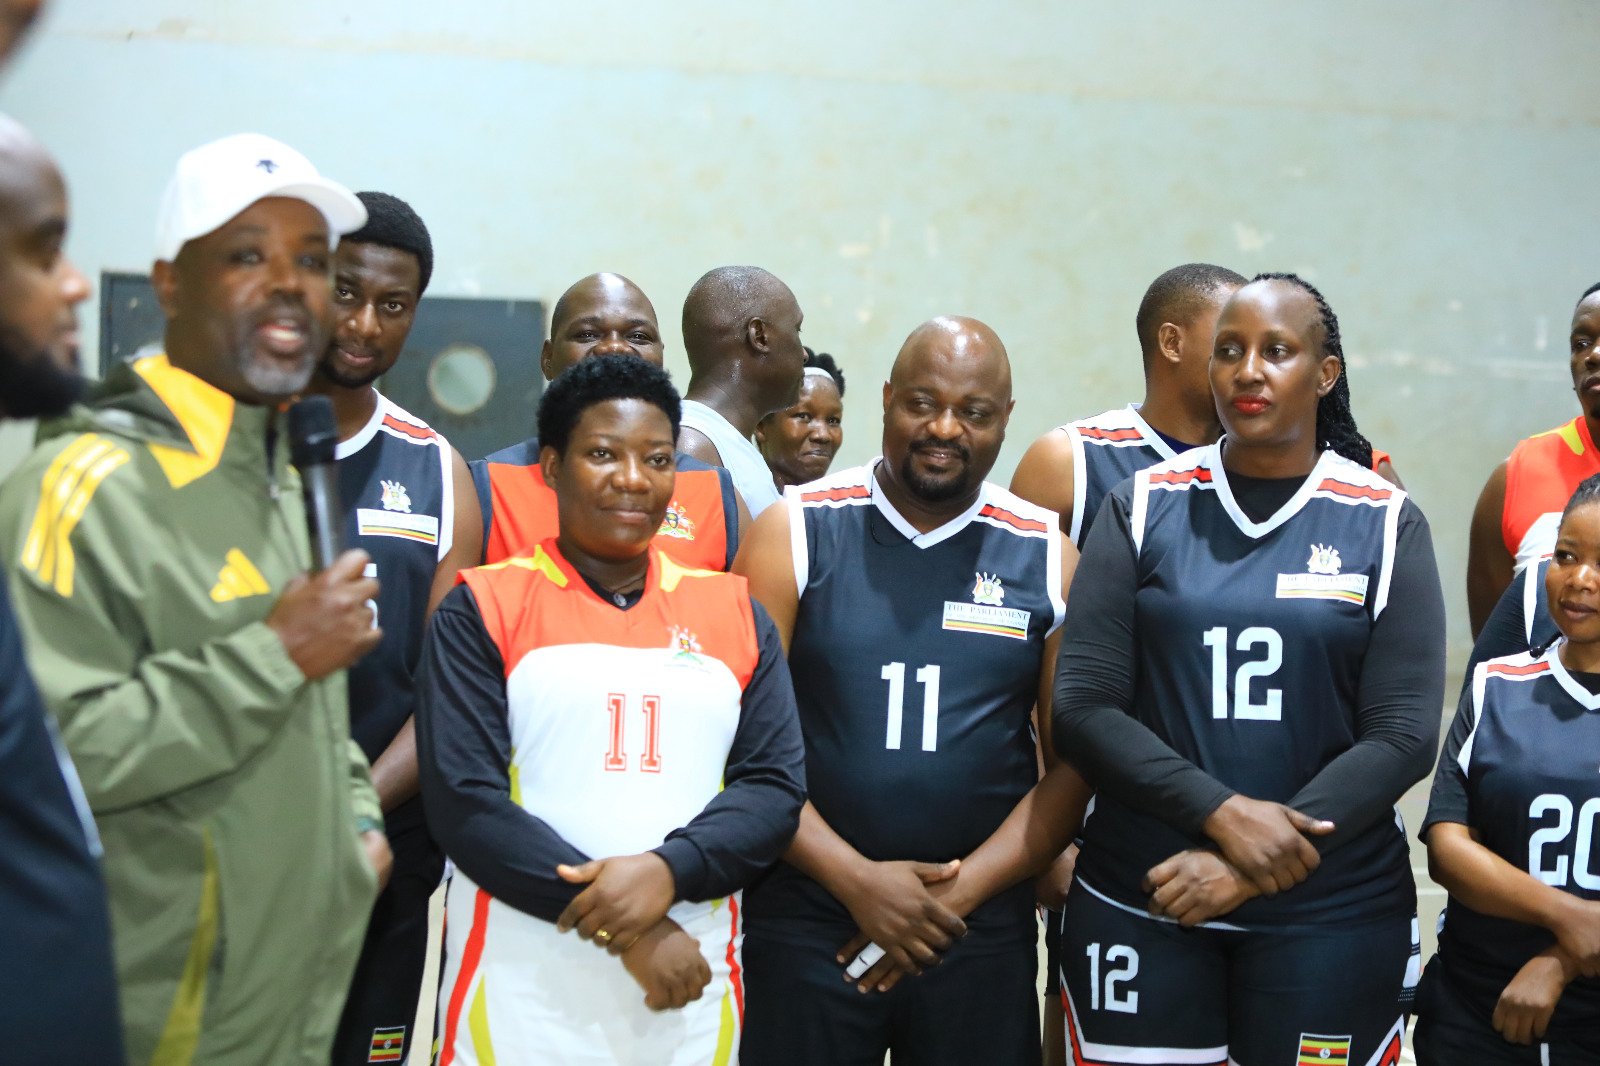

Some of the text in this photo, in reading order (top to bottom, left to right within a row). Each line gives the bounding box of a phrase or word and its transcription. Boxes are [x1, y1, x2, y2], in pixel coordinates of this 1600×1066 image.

[880, 661, 941, 752] 11
[1203, 626, 1283, 721] 12
[604, 692, 662, 773] 11
[1086, 942, 1139, 1014] 12
